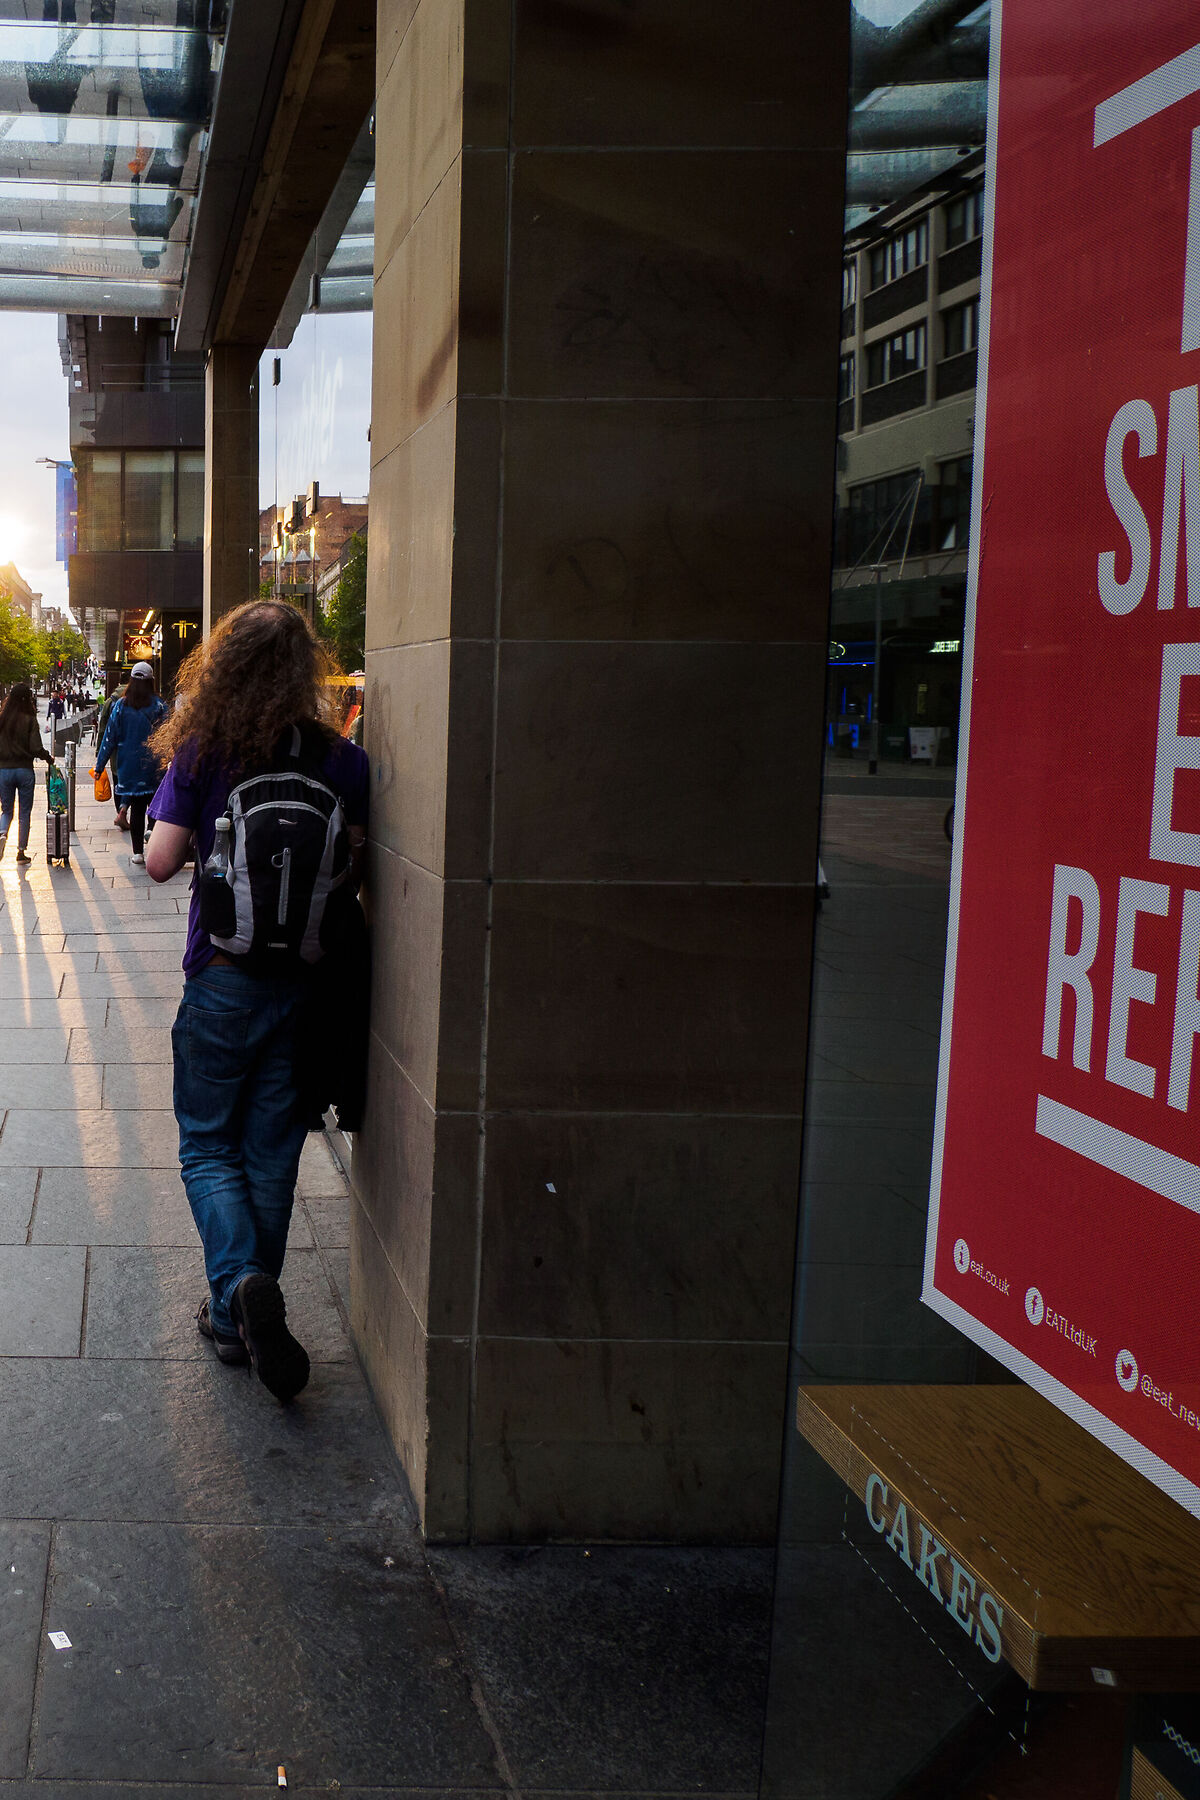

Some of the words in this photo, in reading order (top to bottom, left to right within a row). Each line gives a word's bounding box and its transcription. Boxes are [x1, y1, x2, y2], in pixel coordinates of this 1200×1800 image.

[970, 1260, 1010, 1296] eat.co.uk
[1046, 1306, 1098, 1358] EATLtdUK
[865, 1473, 1004, 1663] CAKES
